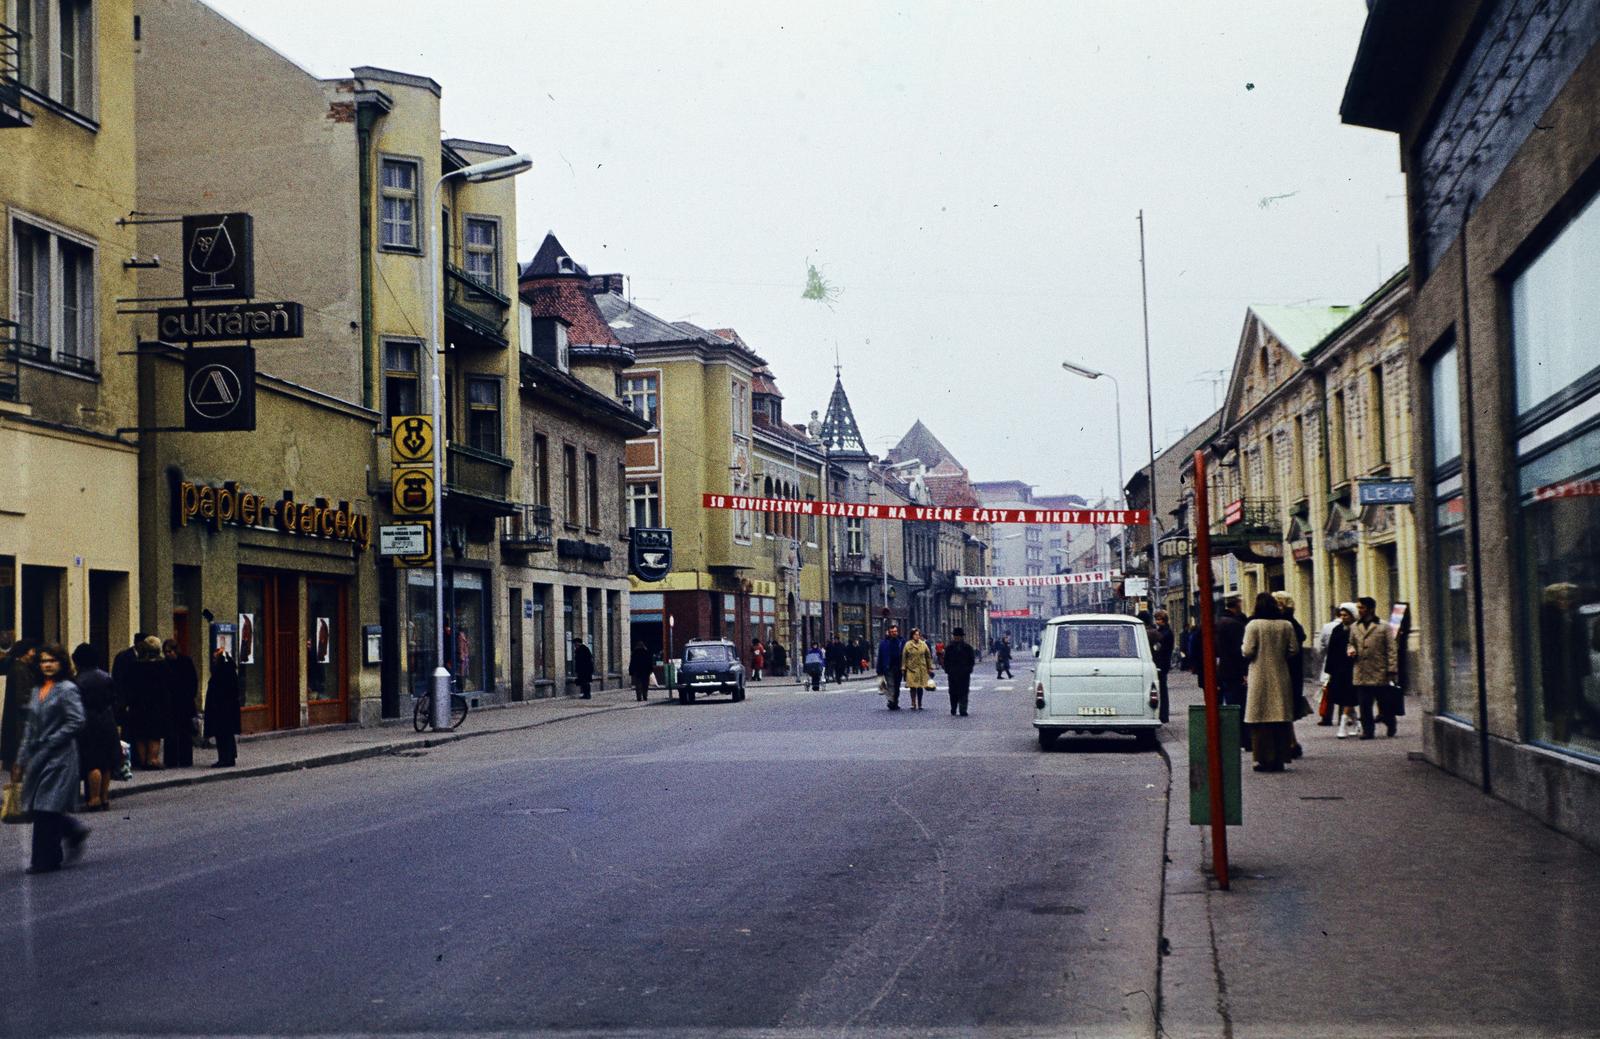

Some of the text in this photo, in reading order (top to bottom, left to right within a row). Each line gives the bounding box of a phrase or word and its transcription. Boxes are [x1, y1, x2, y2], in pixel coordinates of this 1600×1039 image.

[162, 303, 289, 338] cukráreň
[181, 481, 267, 531] papier
[709, 495, 725, 508] SO
[731, 497, 813, 514] SOVIETSKYM
[888, 507, 907, 520] NA
[972, 508, 1008, 522] ČASY
[1017, 511, 1027, 523] A
[1035, 511, 1081, 523] NIKDY
[1089, 511, 1126, 524] INAK
